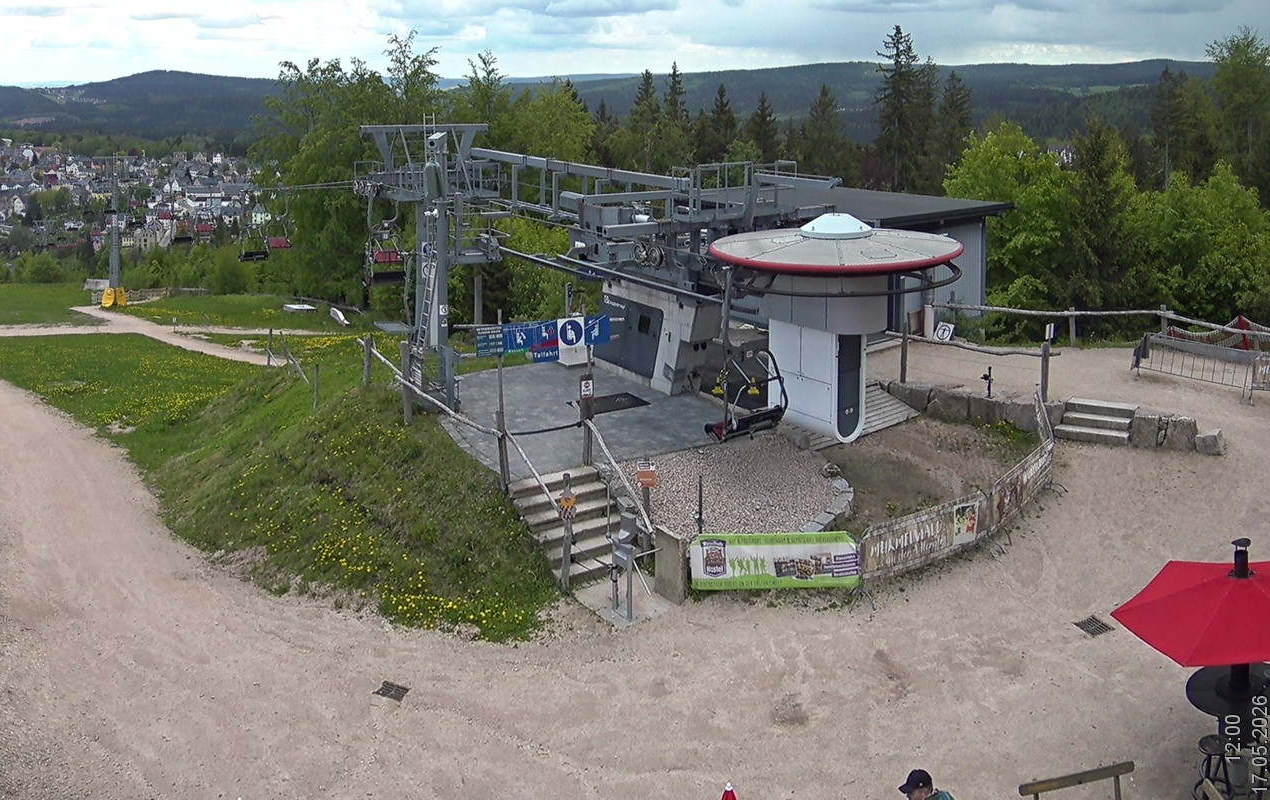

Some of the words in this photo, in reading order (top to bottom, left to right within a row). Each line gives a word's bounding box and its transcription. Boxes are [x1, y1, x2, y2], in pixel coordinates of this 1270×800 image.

[533, 350, 559, 359] Talfahrt
[870, 520, 944, 557] MURMELWALD
[706, 565, 724, 573] Hostel
